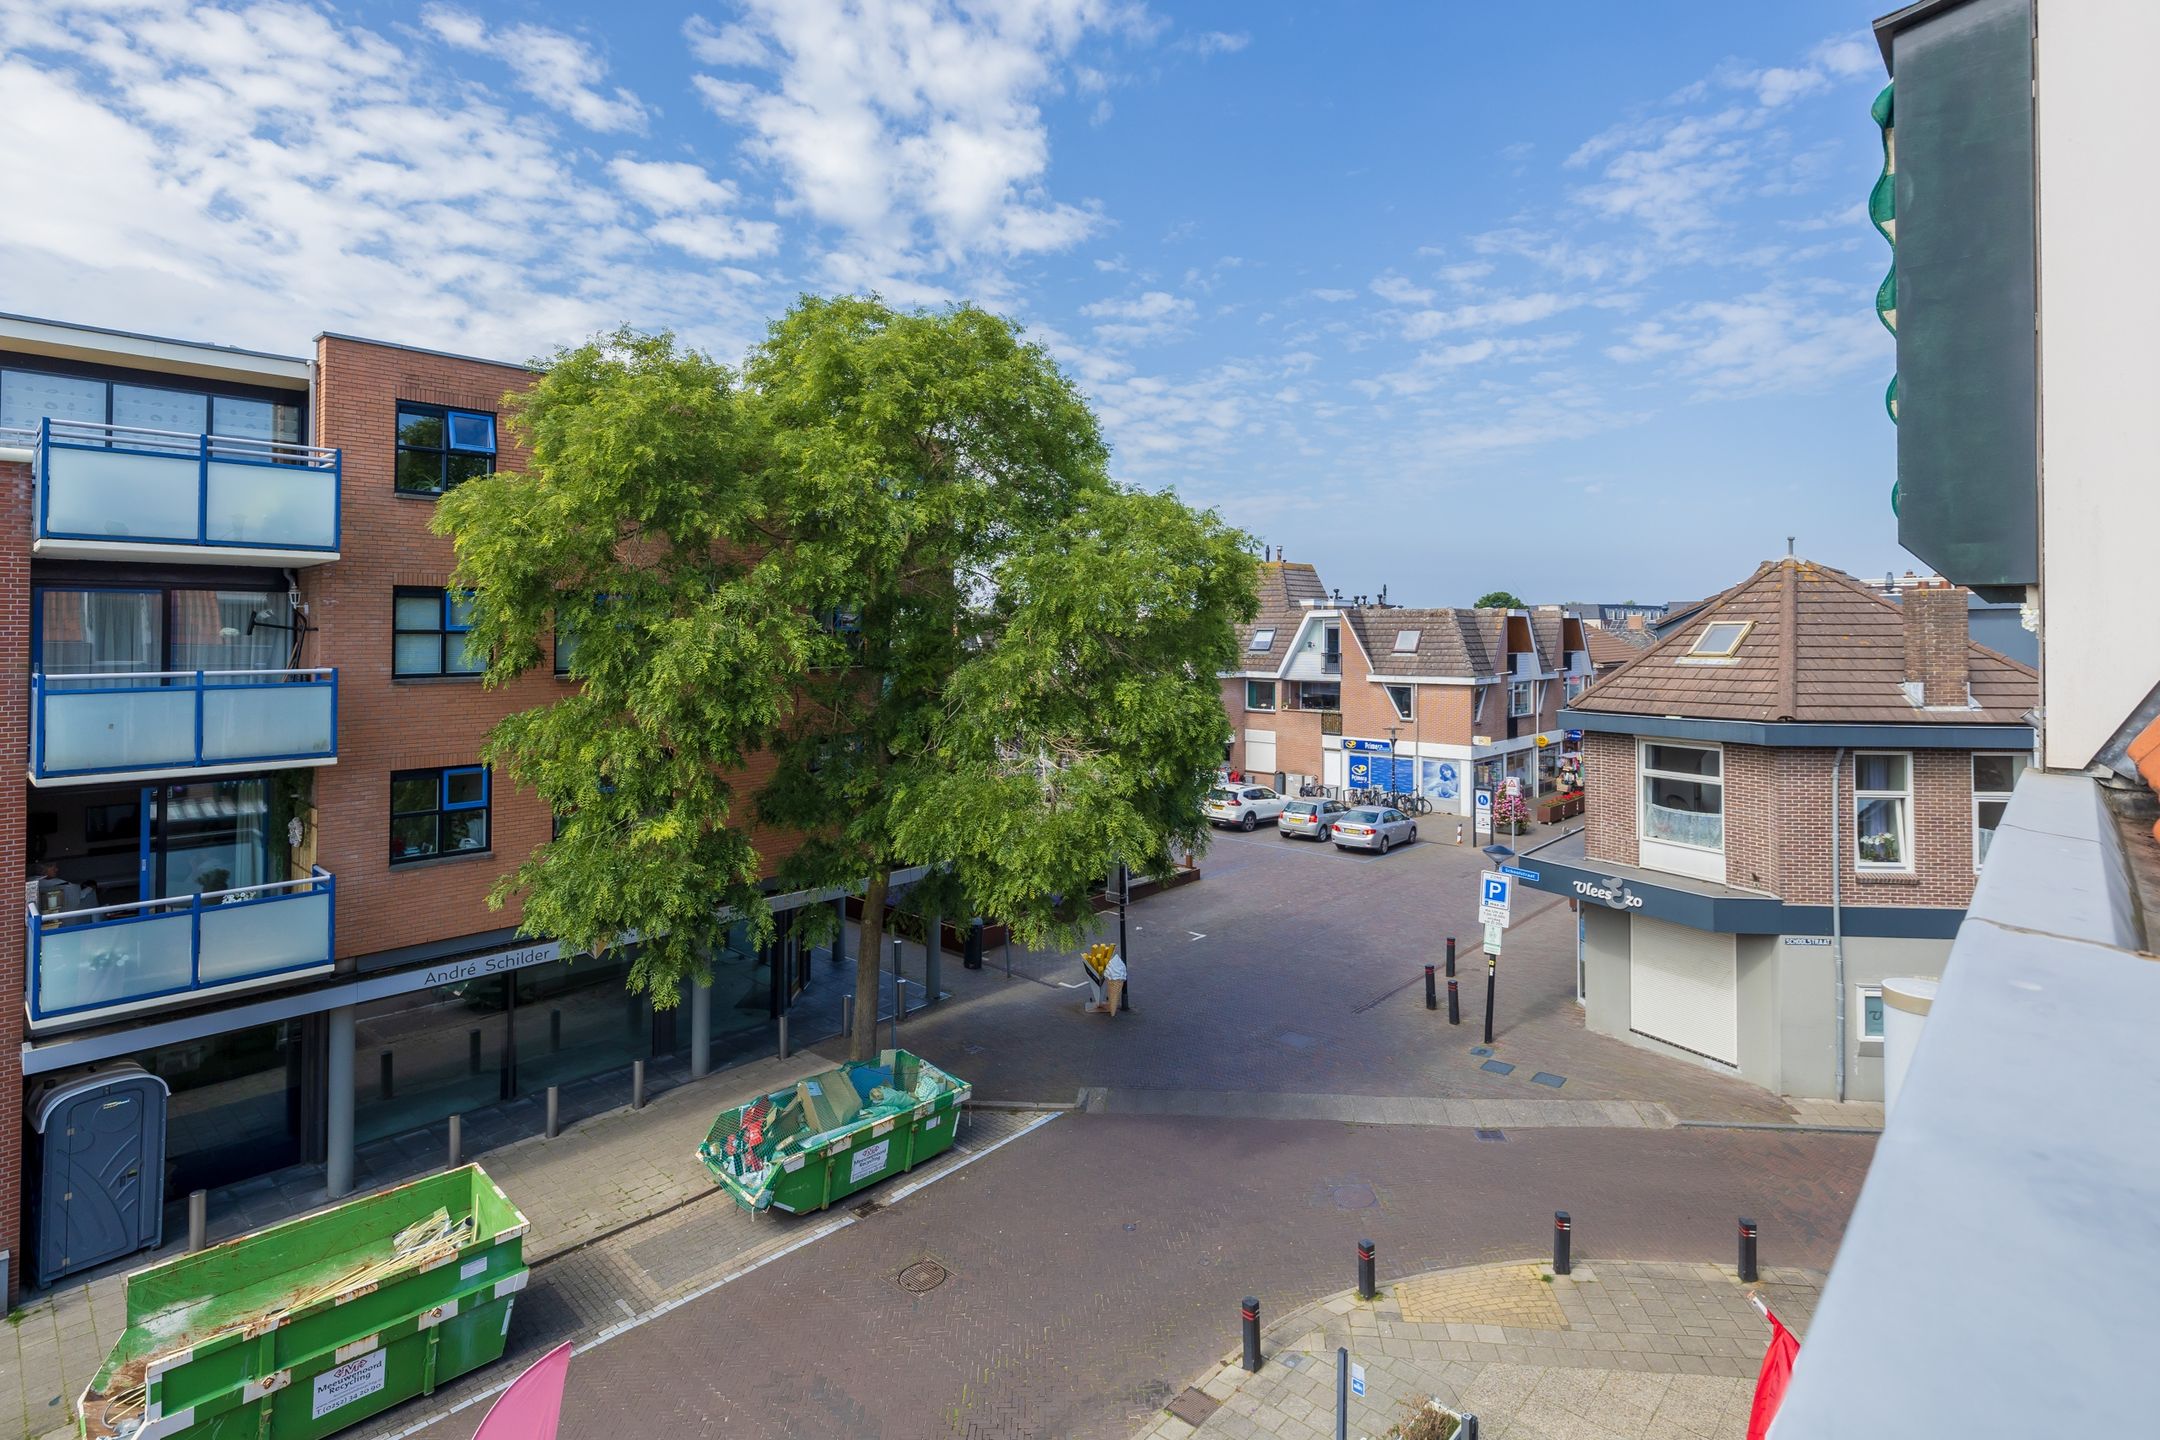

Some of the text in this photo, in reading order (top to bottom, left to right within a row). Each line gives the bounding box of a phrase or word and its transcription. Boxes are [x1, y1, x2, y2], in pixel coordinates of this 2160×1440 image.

[1504, 867, 1536, 879] Schoolstraat
[1572, 880, 1613, 900] Vlees
[1625, 895, 1643, 907] zo
[423, 949, 550, 986] André Schilder
[317, 1360, 382, 1394] Meeuwenoord
[329, 1372, 371, 1395] Recycling
